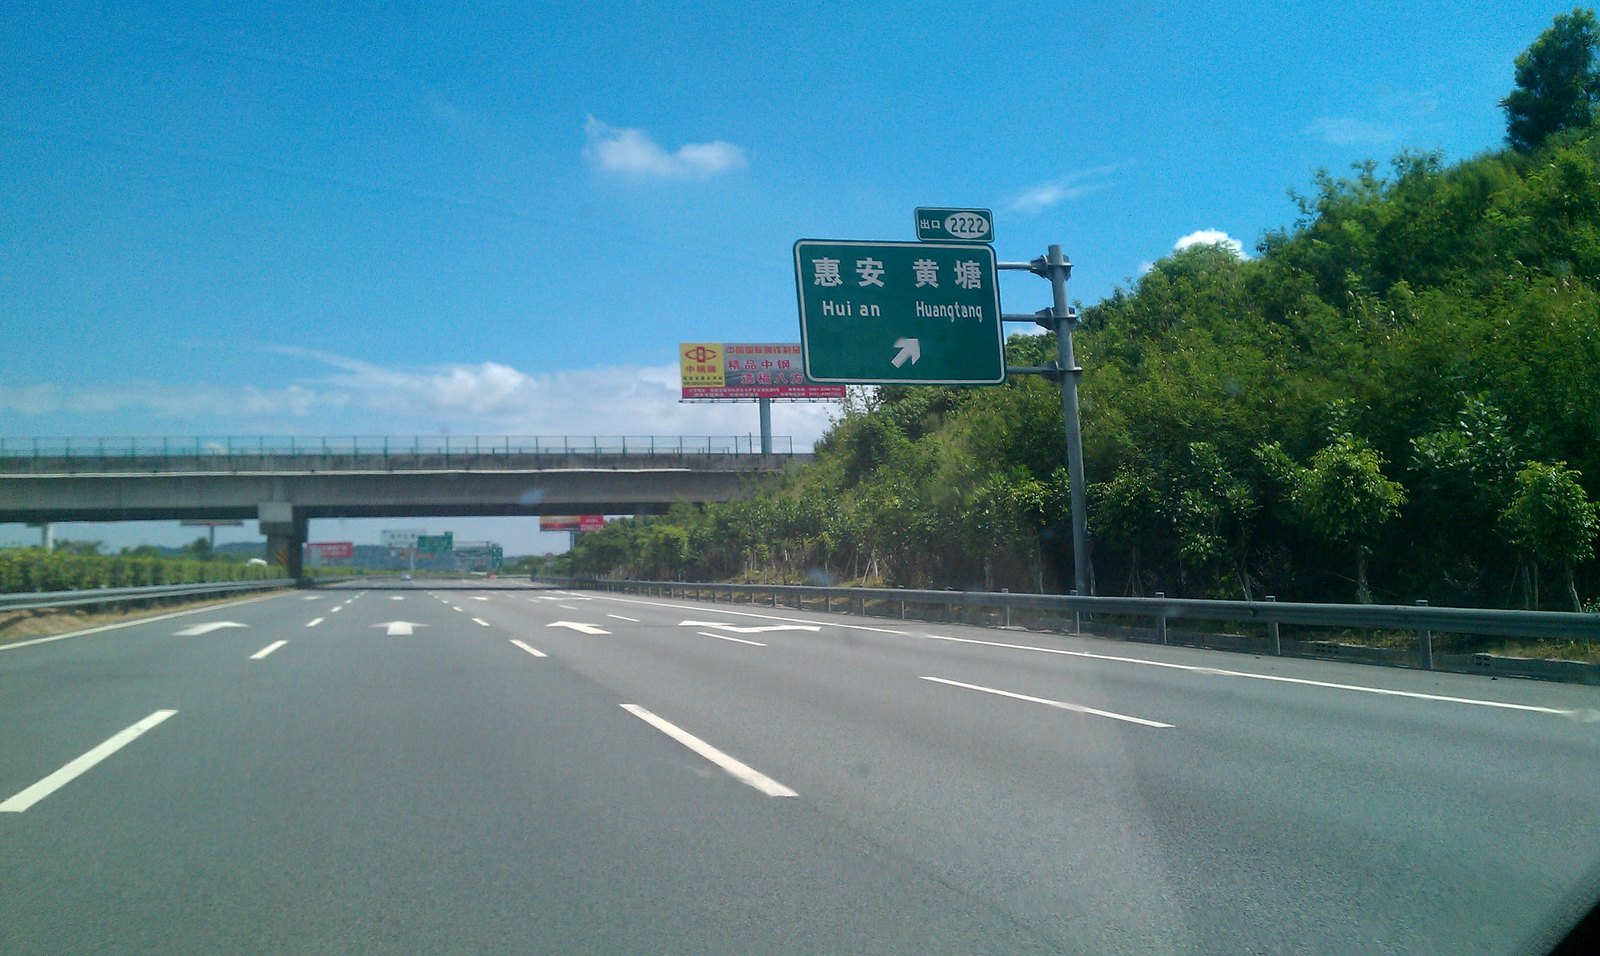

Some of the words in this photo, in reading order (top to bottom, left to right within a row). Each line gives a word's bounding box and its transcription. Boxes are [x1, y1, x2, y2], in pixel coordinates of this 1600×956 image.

[920, 218, 941, 230] 出口
[950, 217, 985, 233] 2222
[812, 257, 885, 288] 惠安
[912, 258, 982, 290] 黄塘
[822, 300, 853, 316] Hui
[859, 303, 881, 317] an
[915, 300, 983, 324] Huangtang
